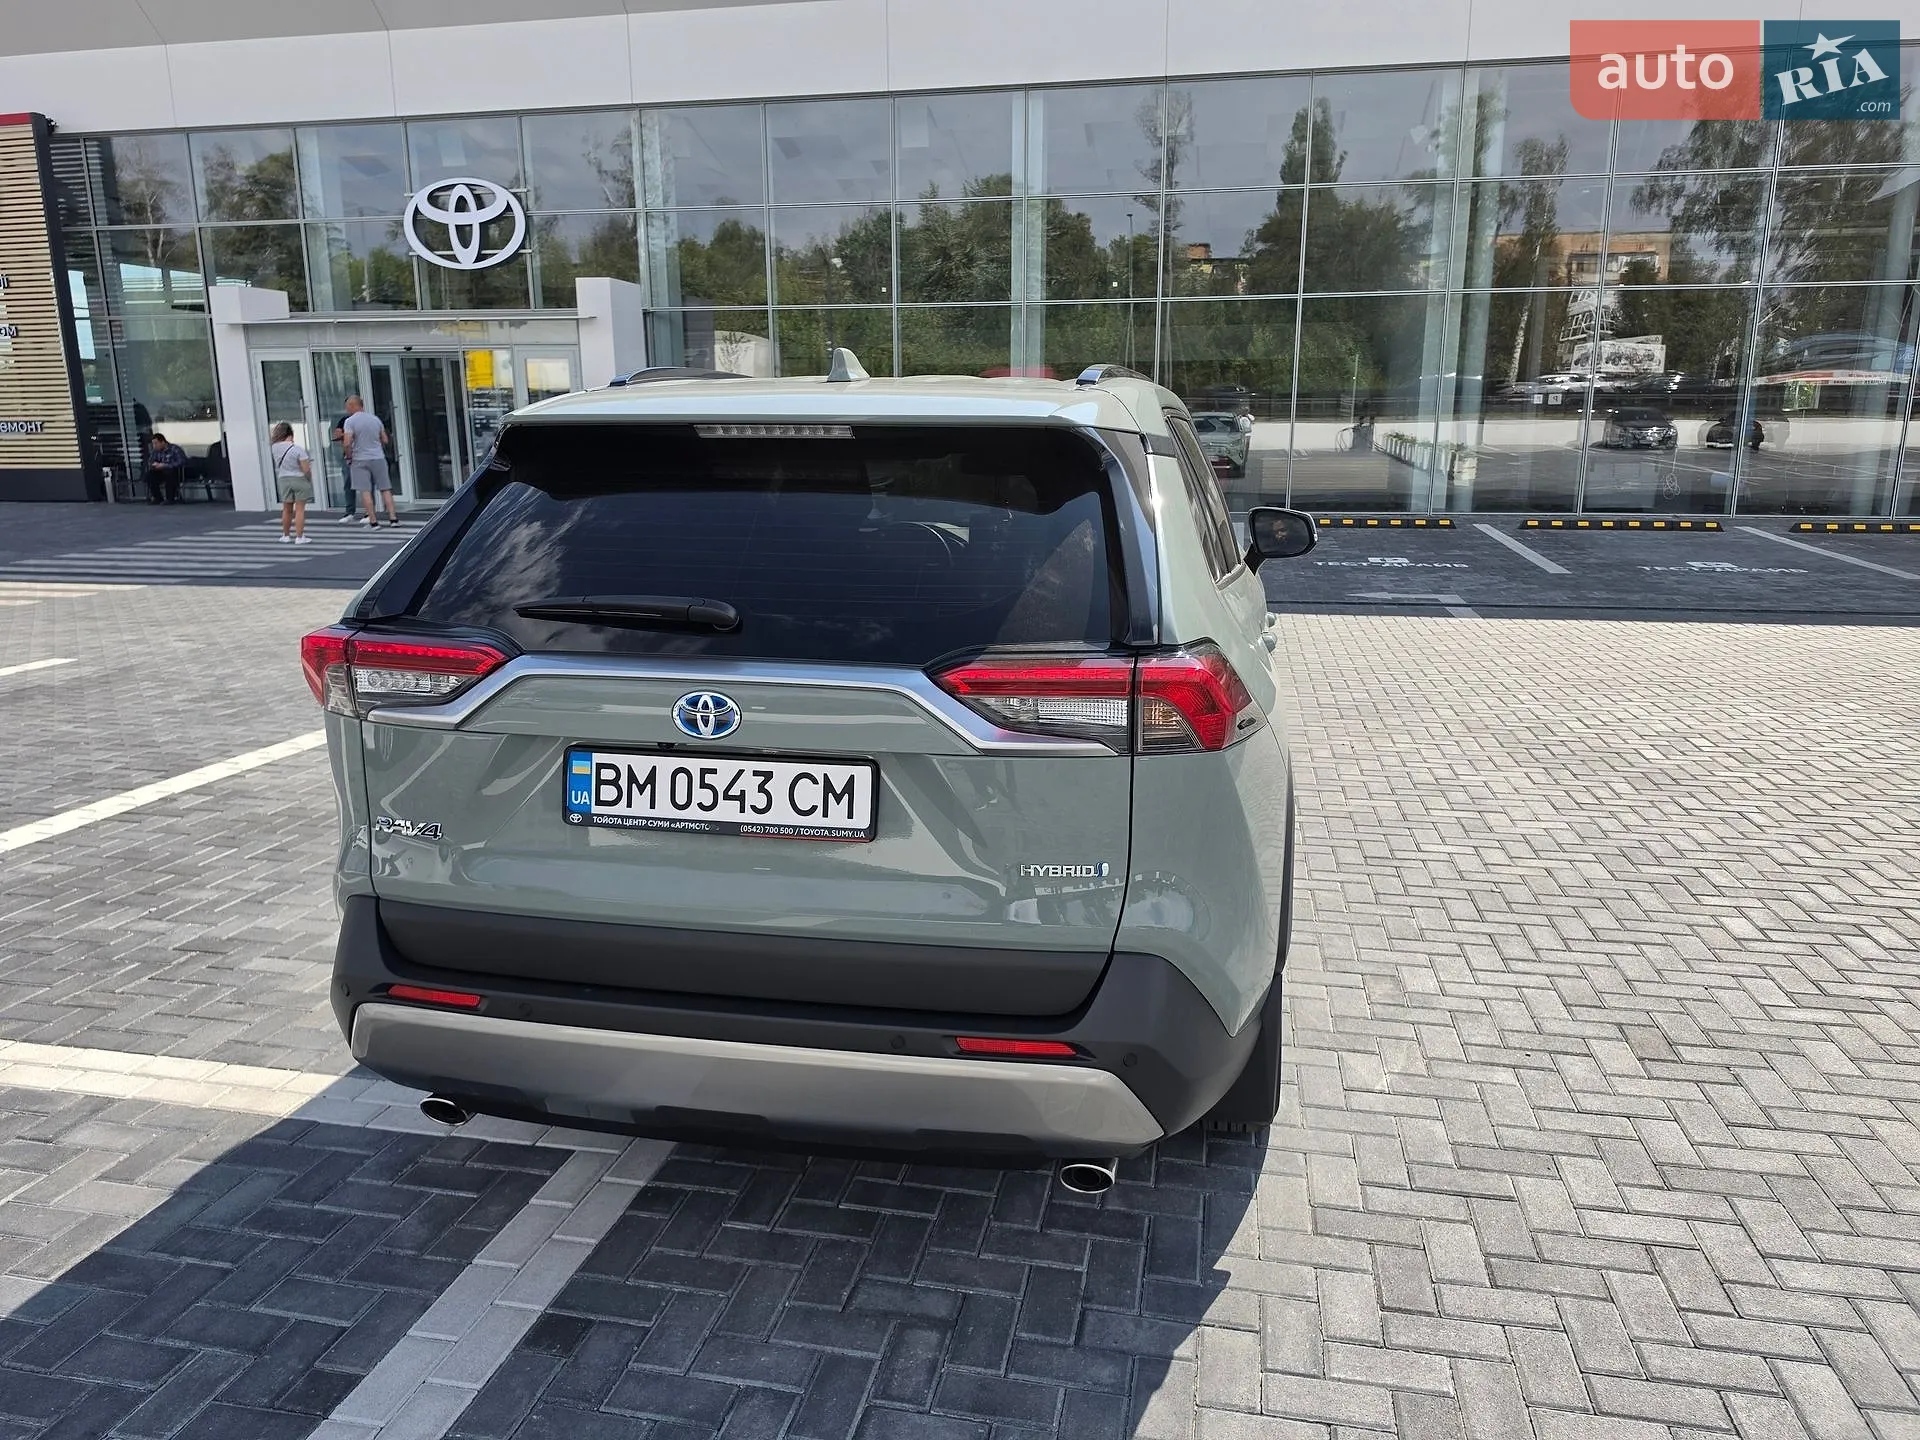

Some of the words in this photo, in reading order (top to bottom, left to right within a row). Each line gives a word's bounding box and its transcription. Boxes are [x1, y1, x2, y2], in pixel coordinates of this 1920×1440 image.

[571, 790, 590, 805] UA
[594, 762, 657, 810] BM
[669, 766, 774, 815] 0543
[787, 771, 855, 820] CM
[375, 815, 442, 841] RAV4
[593, 815, 623, 826] ТОЙОТА
[623, 817, 647, 827] ЦЕНТР
[647, 818, 670, 828] СУМИ
[740, 824, 764, 834] (0542)
[765, 826, 779, 834] 700
[779, 826, 794, 835] 500
[799, 828, 865, 839] TOYOTA.SUMY.UA
[1019, 864, 1096, 877] HYBRID
